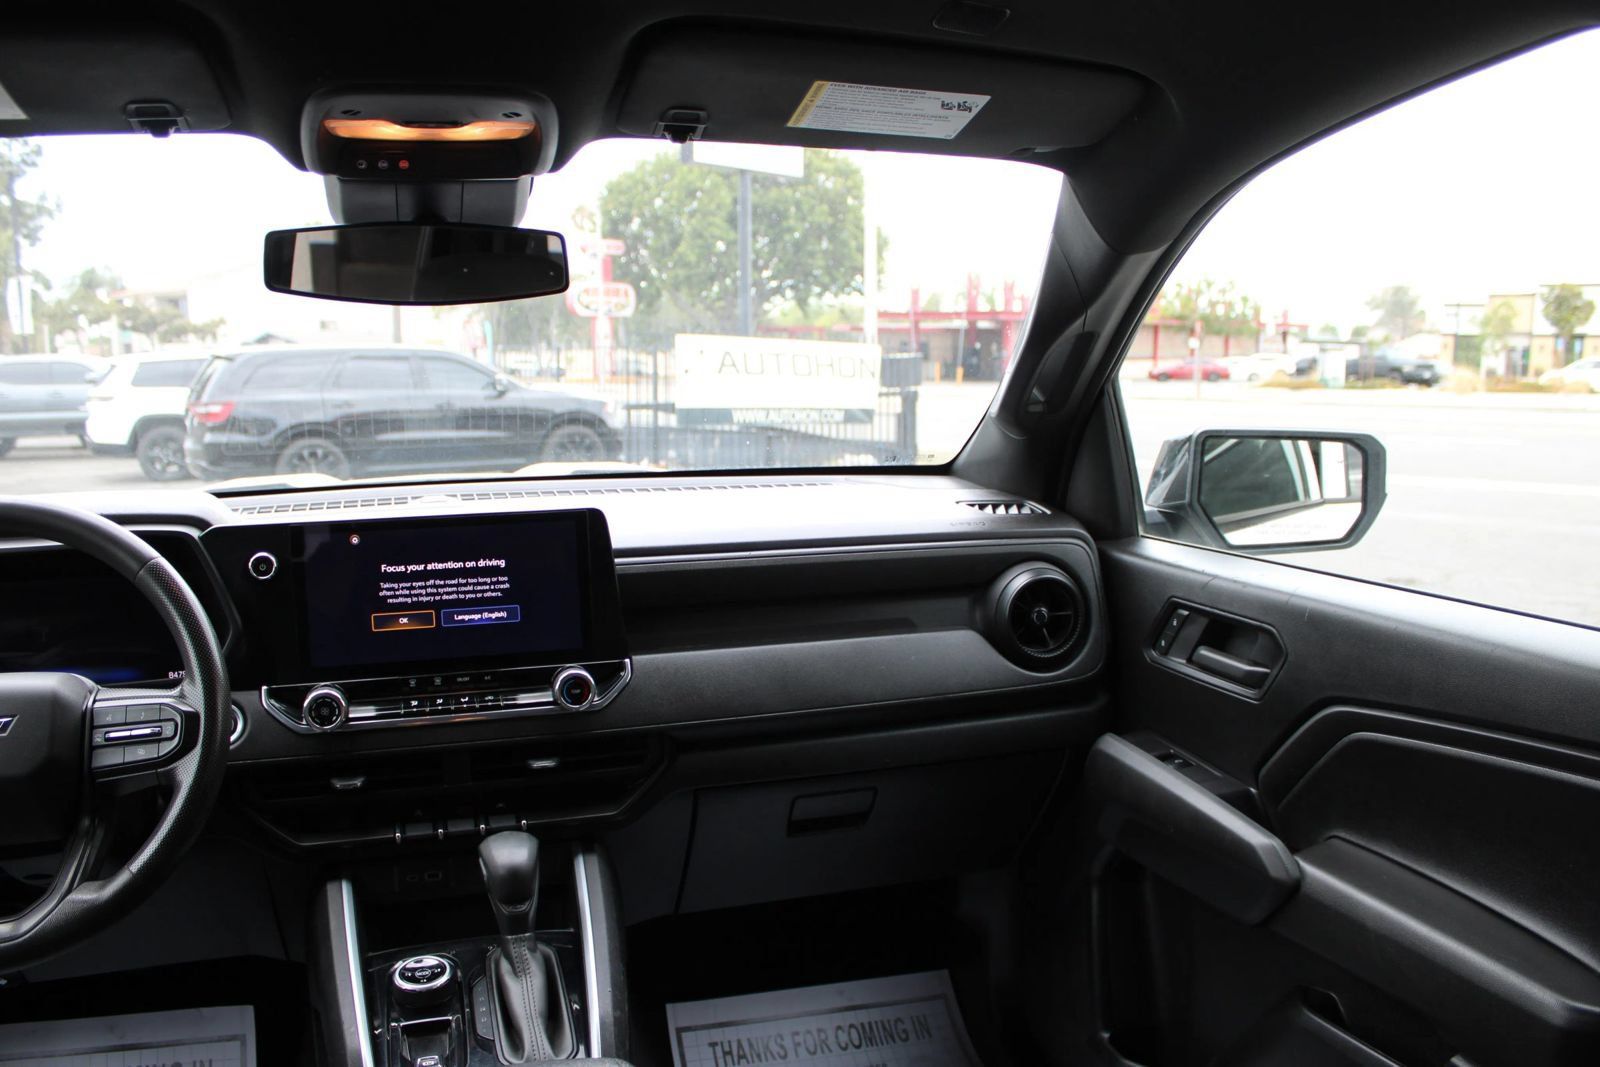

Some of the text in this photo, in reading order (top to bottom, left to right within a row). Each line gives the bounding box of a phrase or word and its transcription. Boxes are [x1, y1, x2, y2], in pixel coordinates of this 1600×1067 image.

[381, 564, 405, 573] Focus
[406, 563, 425, 573] your
[426, 561, 464, 570] attention
[478, 558, 506, 568] driving
[482, 611, 507, 619] (English)
[708, 1014, 933, 1067] THANKS FOR COMING IN
